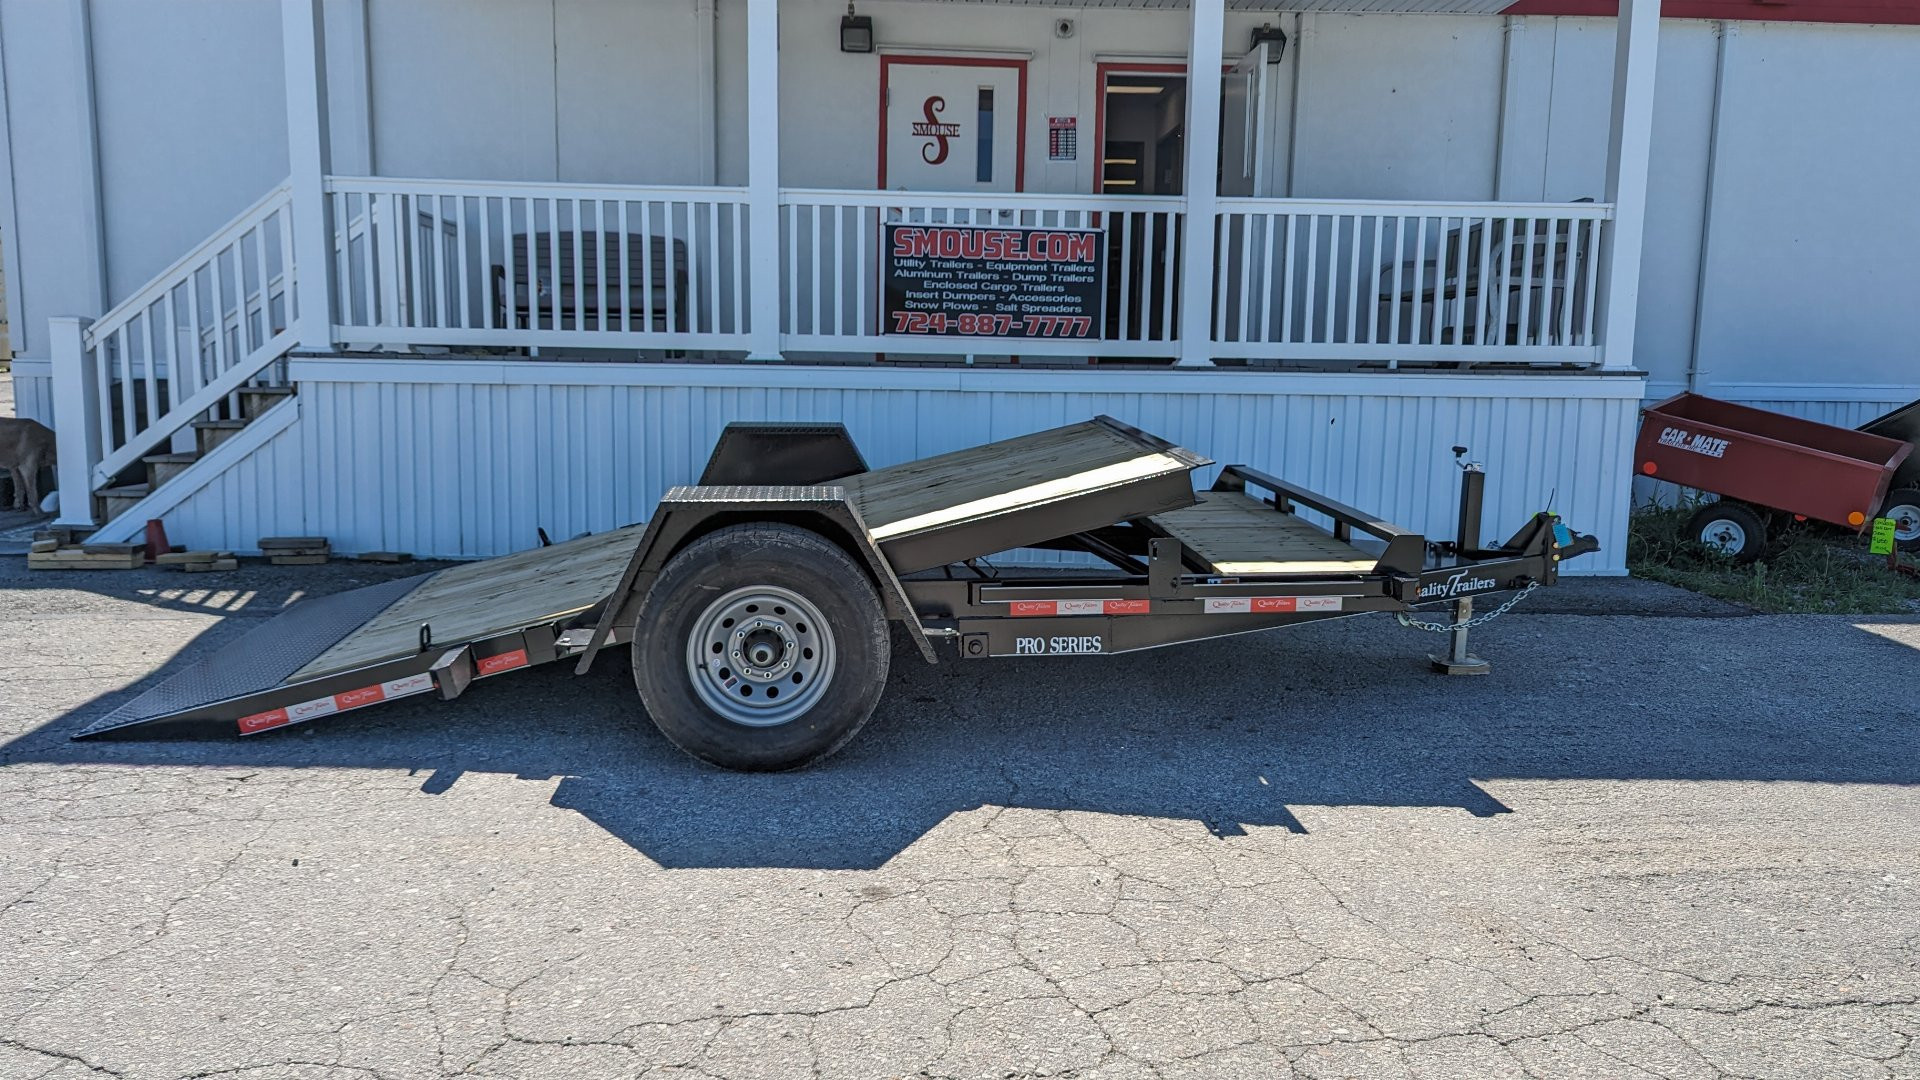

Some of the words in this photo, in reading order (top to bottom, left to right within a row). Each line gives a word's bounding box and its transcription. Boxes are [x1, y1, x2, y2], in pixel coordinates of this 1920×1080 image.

[911, 123, 960, 137] SMOUSE
[893, 227, 1095, 263] SMOUSE.COM
[893, 259, 927, 269] Utility
[930, 260, 974, 270] Trailers
[986, 261, 1048, 272] Equipment
[1051, 263, 1096, 273] Trailers
[894, 269, 953, 279] Aluminum
[956, 270, 1000, 280] Trailers
[1012, 273, 1048, 282] Dump
[1051, 273, 1095, 283] Trailers
[923, 280, 978, 290] Enclosed
[981, 282, 1018, 292] Cargo
[1021, 282, 1066, 292] Trailers
[905, 290, 939, 299] Insert
[942, 291, 996, 302] Dumpers
[1008, 293, 1083, 303] Accessories
[904, 300, 940, 309] Snow
[942, 301, 979, 311] Plows
[995, 303, 1018, 312] Salt
[1021, 303, 1083, 314] Spreaders
[892, 311, 1093, 337] 724-887-7777
[1660, 427, 1689, 444] CAR
[1690, 434, 1729, 454] MATE
[1447, 569, 1496, 596] Trailers
[1015, 637, 1046, 654] PRO
[1049, 635, 1102, 653] SERIES
